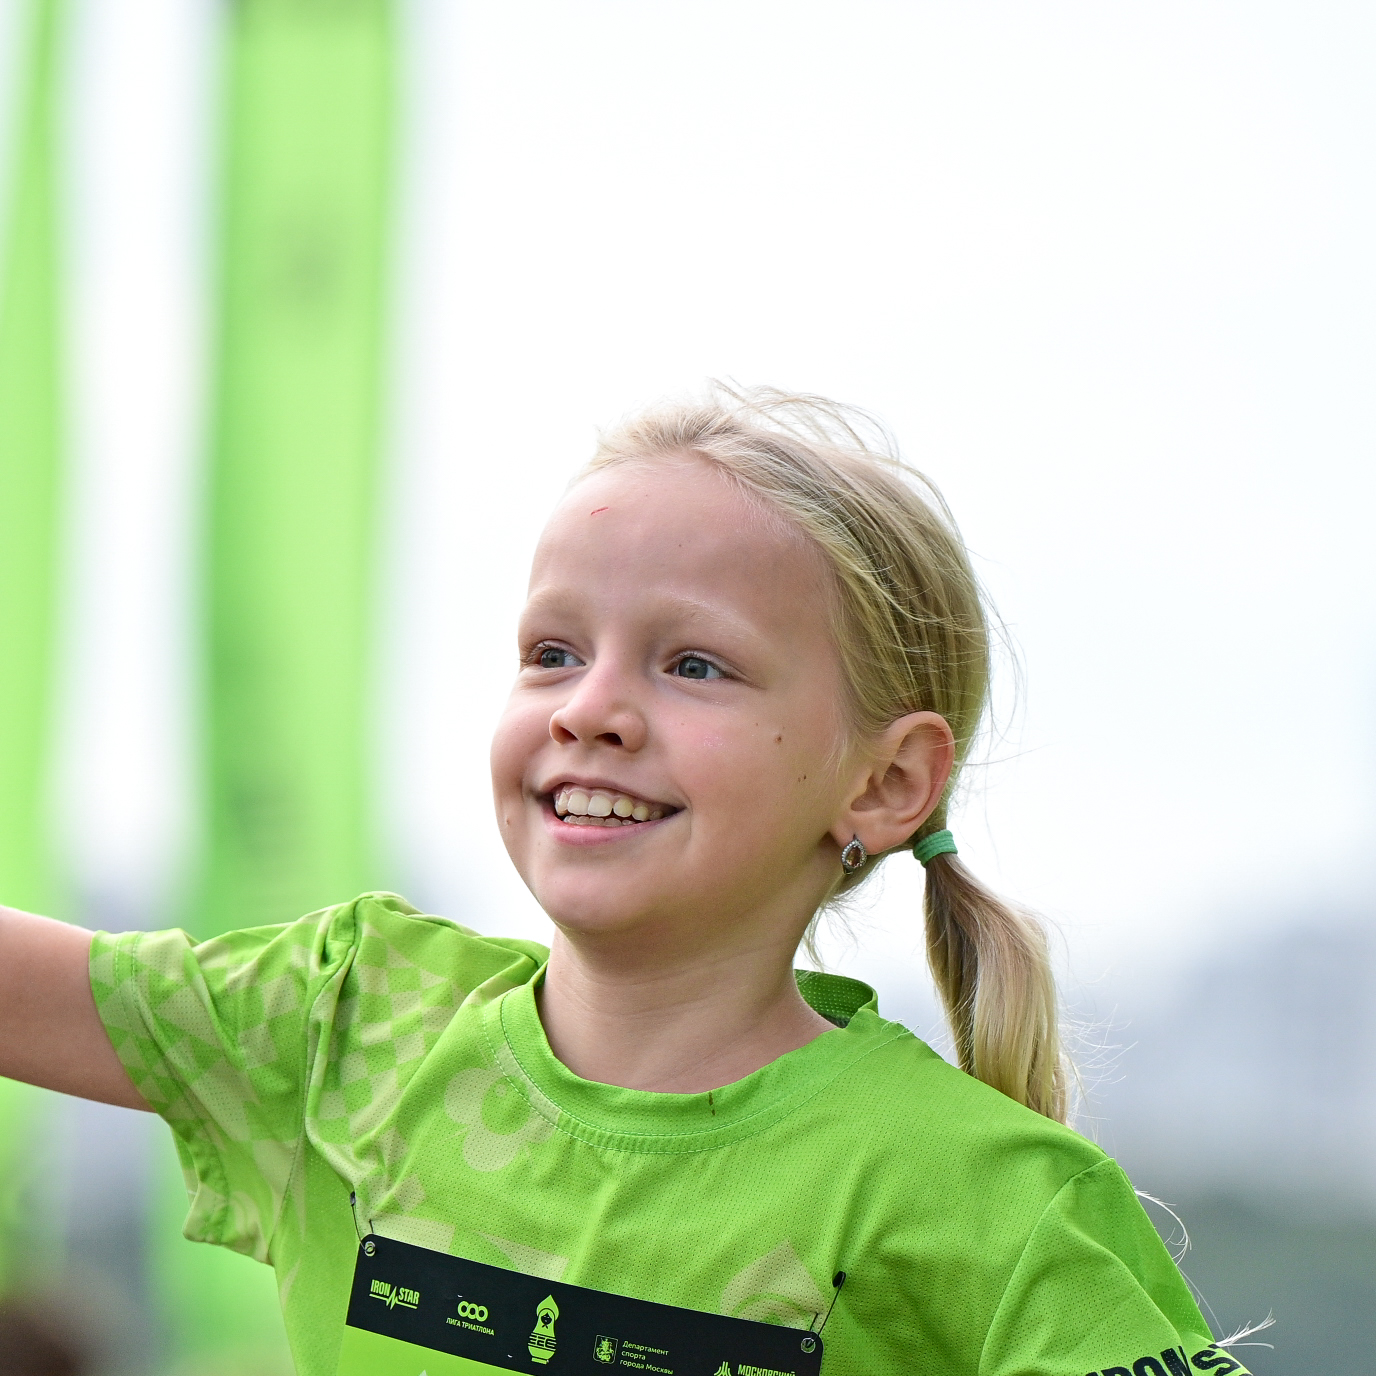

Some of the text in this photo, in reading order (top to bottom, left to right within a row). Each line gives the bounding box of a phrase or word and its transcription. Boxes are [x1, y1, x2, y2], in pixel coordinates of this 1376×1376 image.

[371, 1279, 420, 1305] IRON STAR
[445, 1317, 495, 1336] ЛИГА ТРИАТЛОНА
[621, 1350, 646, 1361] спорта
[622, 1340, 669, 1356] Департамент
[619, 1359, 674, 1375] города Москвы
